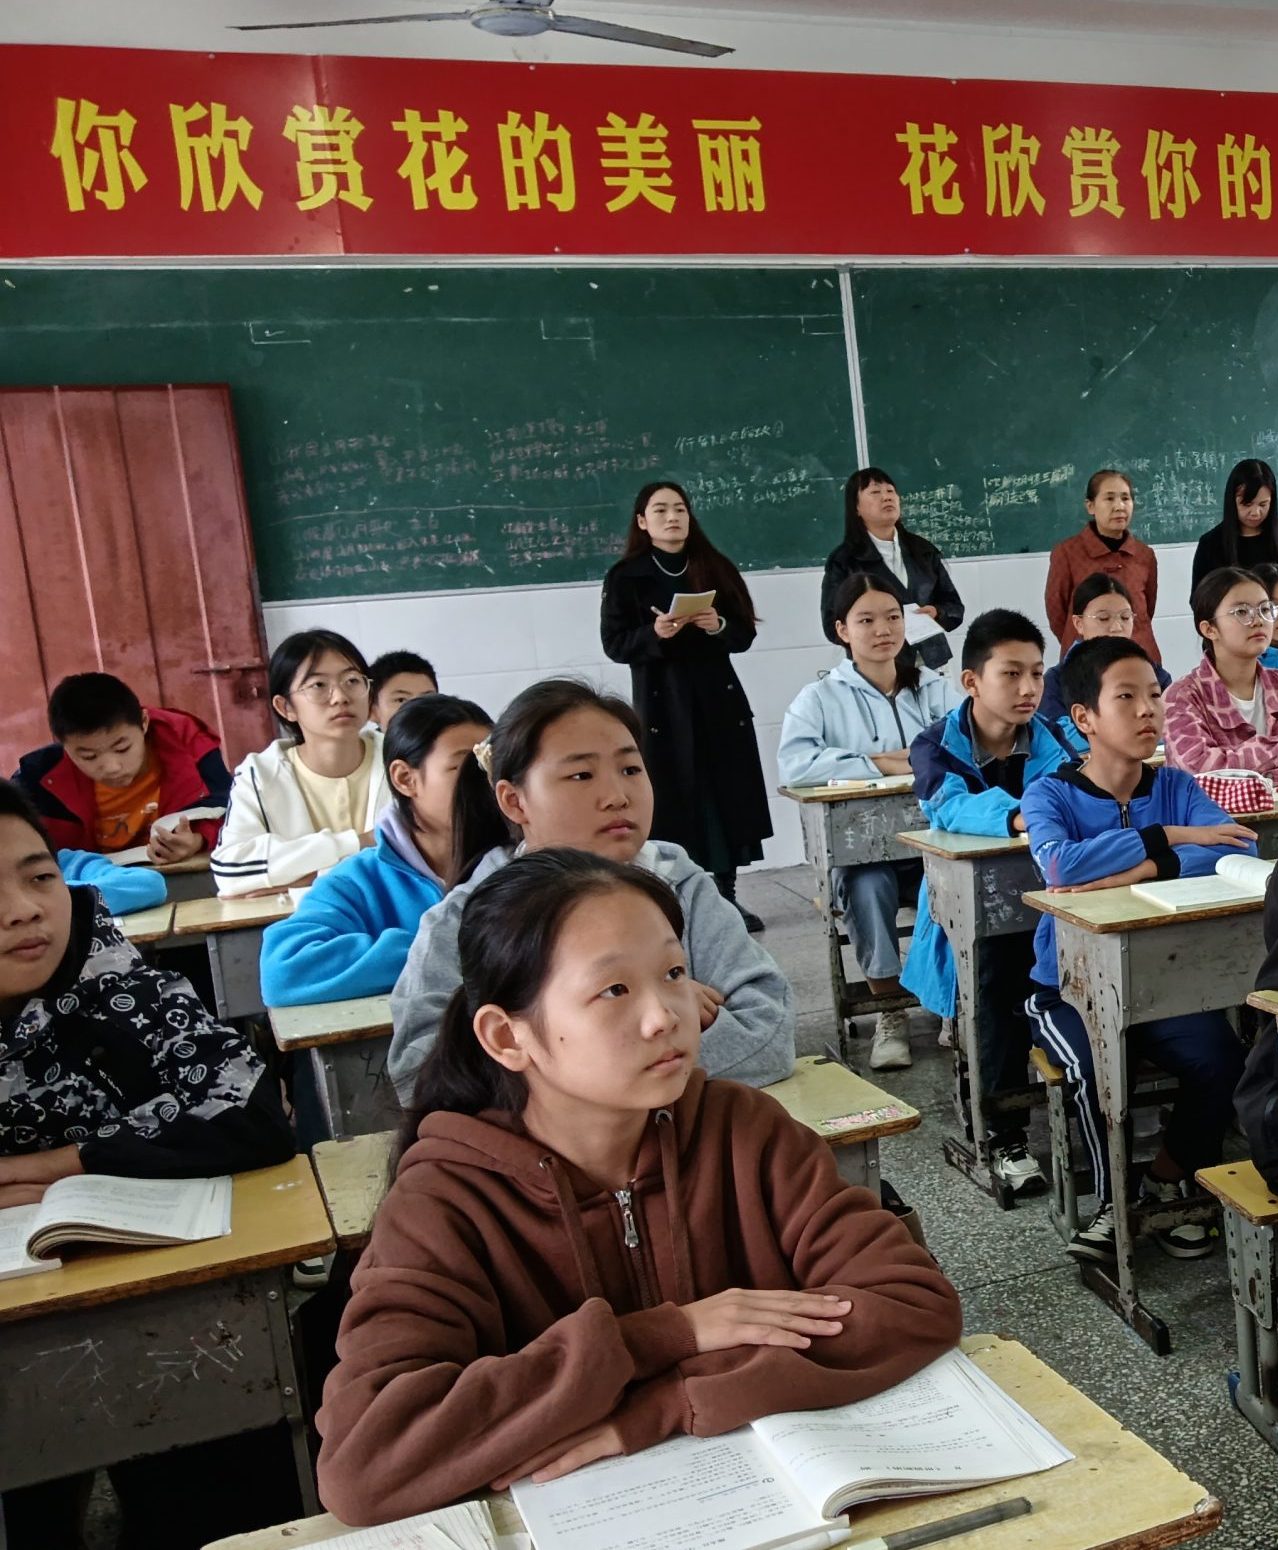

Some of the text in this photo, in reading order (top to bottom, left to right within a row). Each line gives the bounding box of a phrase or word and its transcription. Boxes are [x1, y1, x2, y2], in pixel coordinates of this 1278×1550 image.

[50, 97, 766, 213] 你欣赏花的美丽
